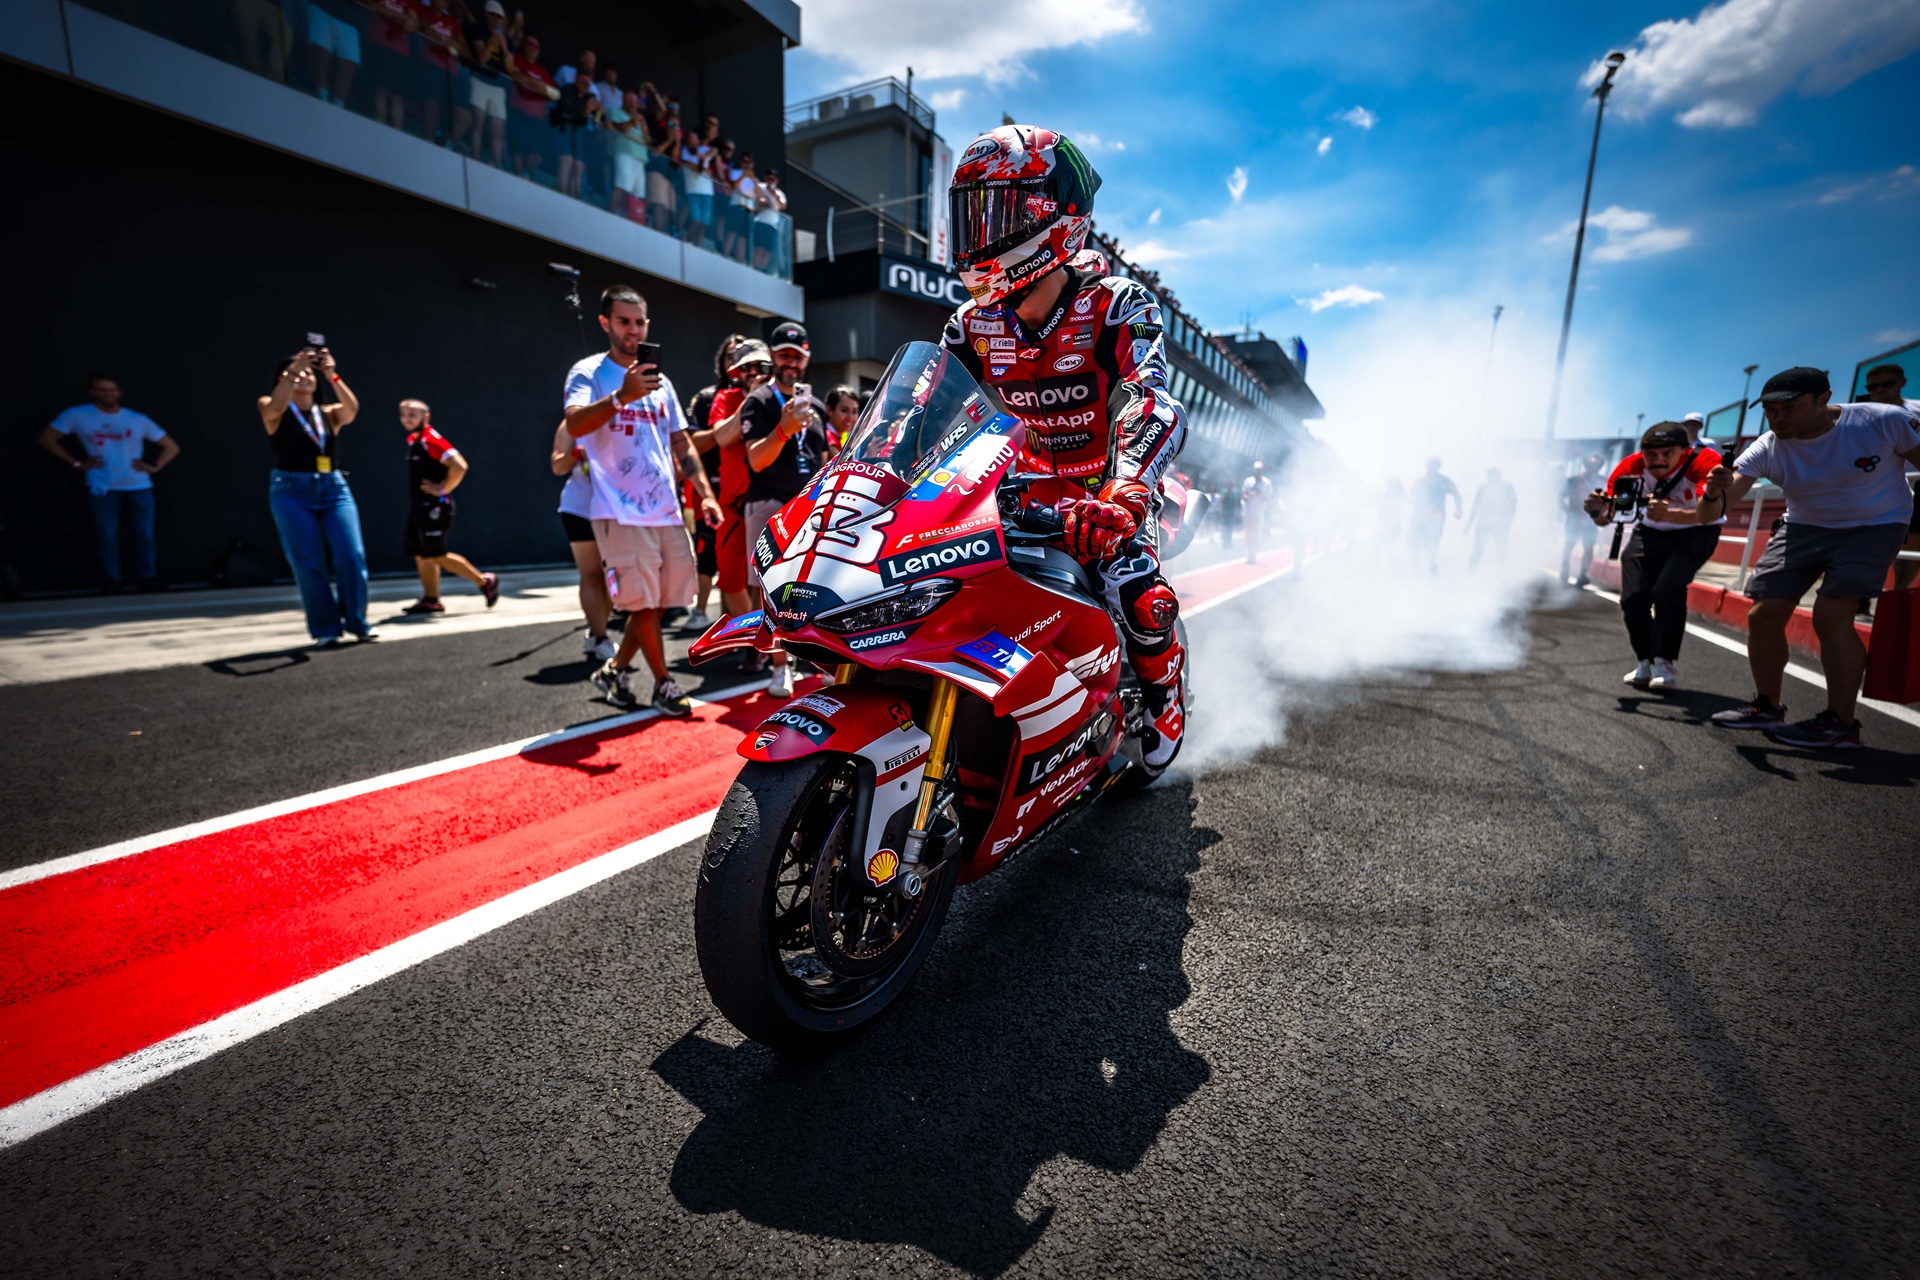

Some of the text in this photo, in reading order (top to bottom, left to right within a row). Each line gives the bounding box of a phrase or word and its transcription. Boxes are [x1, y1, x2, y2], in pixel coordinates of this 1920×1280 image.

[962, 145, 993, 159] UOMY
[1042, 201, 1057, 212] 63
[1066, 223, 1088, 246] SUOM
[1010, 249, 1052, 279] Lenovo
[970, 285, 989, 296] COTTO
[1012, 323, 1024, 340] TIM
[1037, 307, 1065, 340] Lenovo
[991, 367, 1006, 376] SAP
[998, 384, 1089, 407] Lenovo
[940, 421, 968, 451] WRS
[1132, 421, 1162, 459] Lenovo
[1039, 459, 1106, 477] FRECIAROSSA
[782, 490, 898, 567] 63
[918, 516, 995, 540] FRECCIAROSSA
[888, 540, 990, 579] Lenovo
[1033, 610, 1062, 634] Sport
[849, 631, 906, 650] CARRERA
[991, 647, 1014, 672] TI
[765, 711, 824, 736] enovo
[884, 745, 921, 772] PIRELLI
